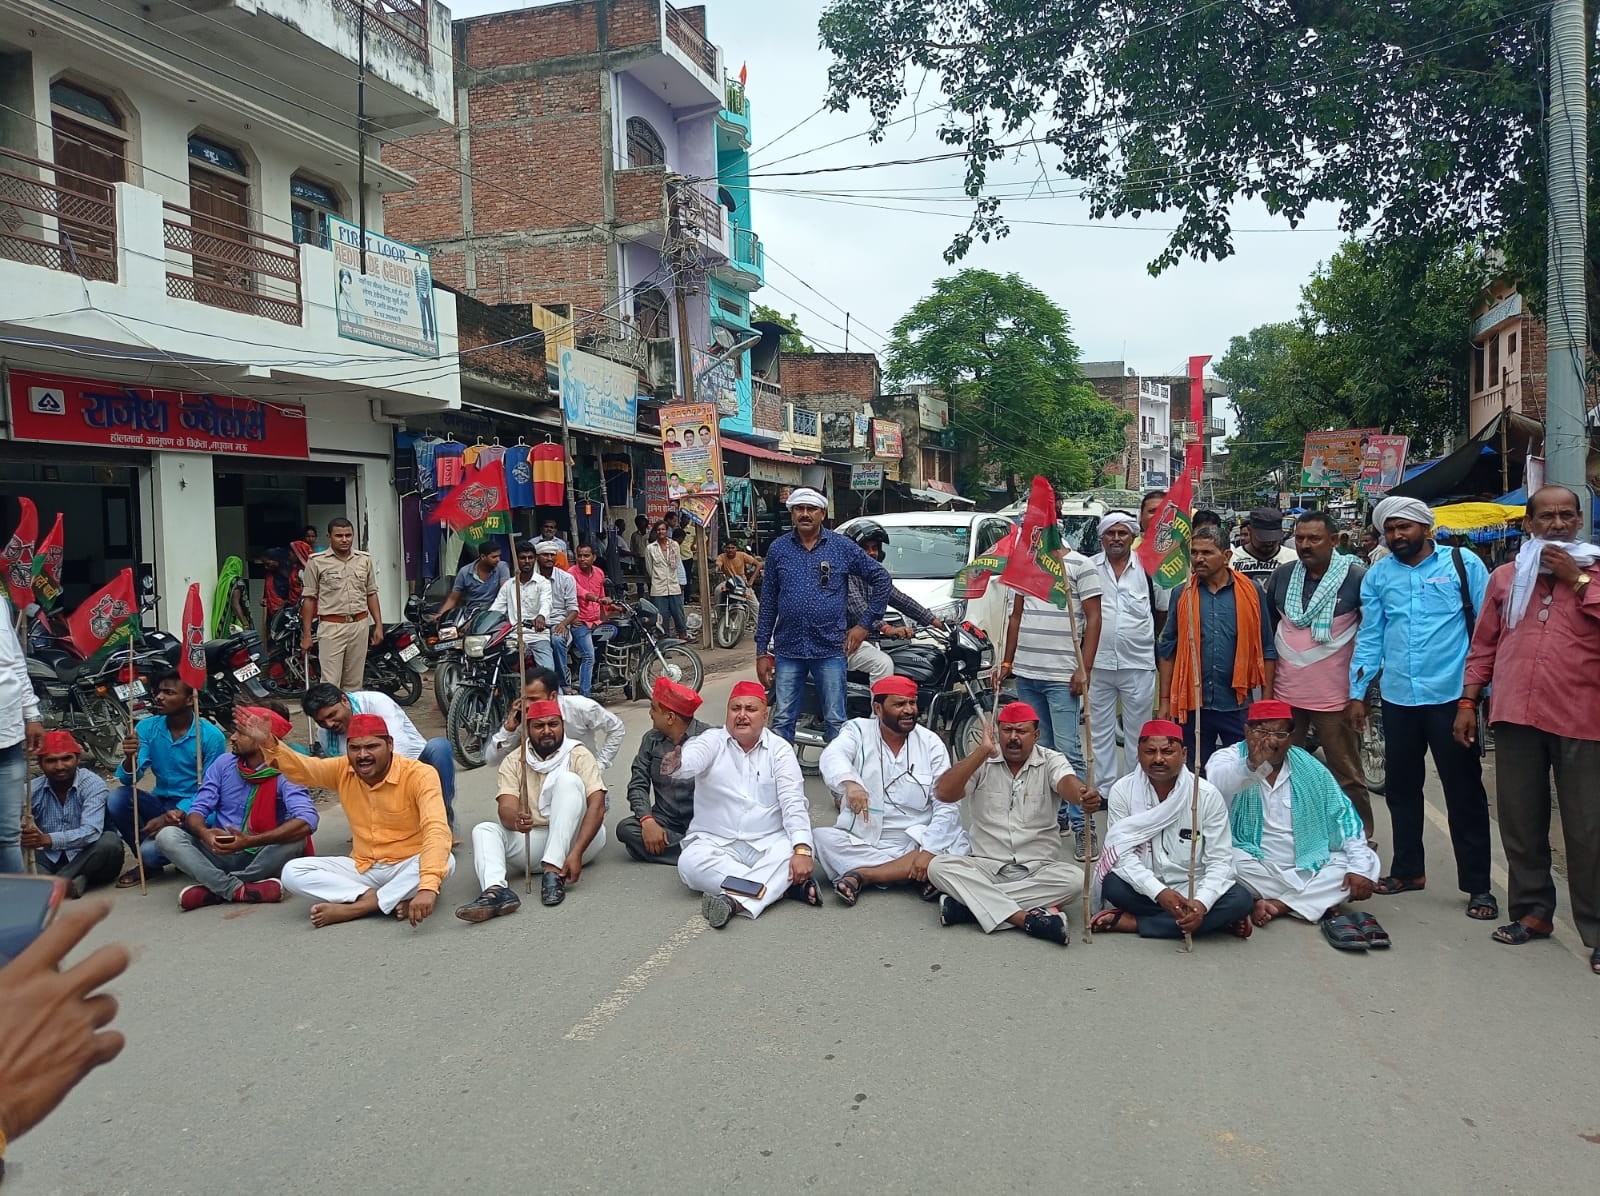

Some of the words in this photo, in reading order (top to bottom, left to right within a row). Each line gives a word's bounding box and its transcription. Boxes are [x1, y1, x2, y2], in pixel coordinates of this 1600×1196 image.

[338, 226, 372, 251] FIRT
[377, 241, 407, 264] LOOK
[382, 260, 414, 287] CENTER
[79, 386, 169, 433] राजेश
[176, 437, 184, 446] के
[1232, 559, 1281, 572] Manhatt
